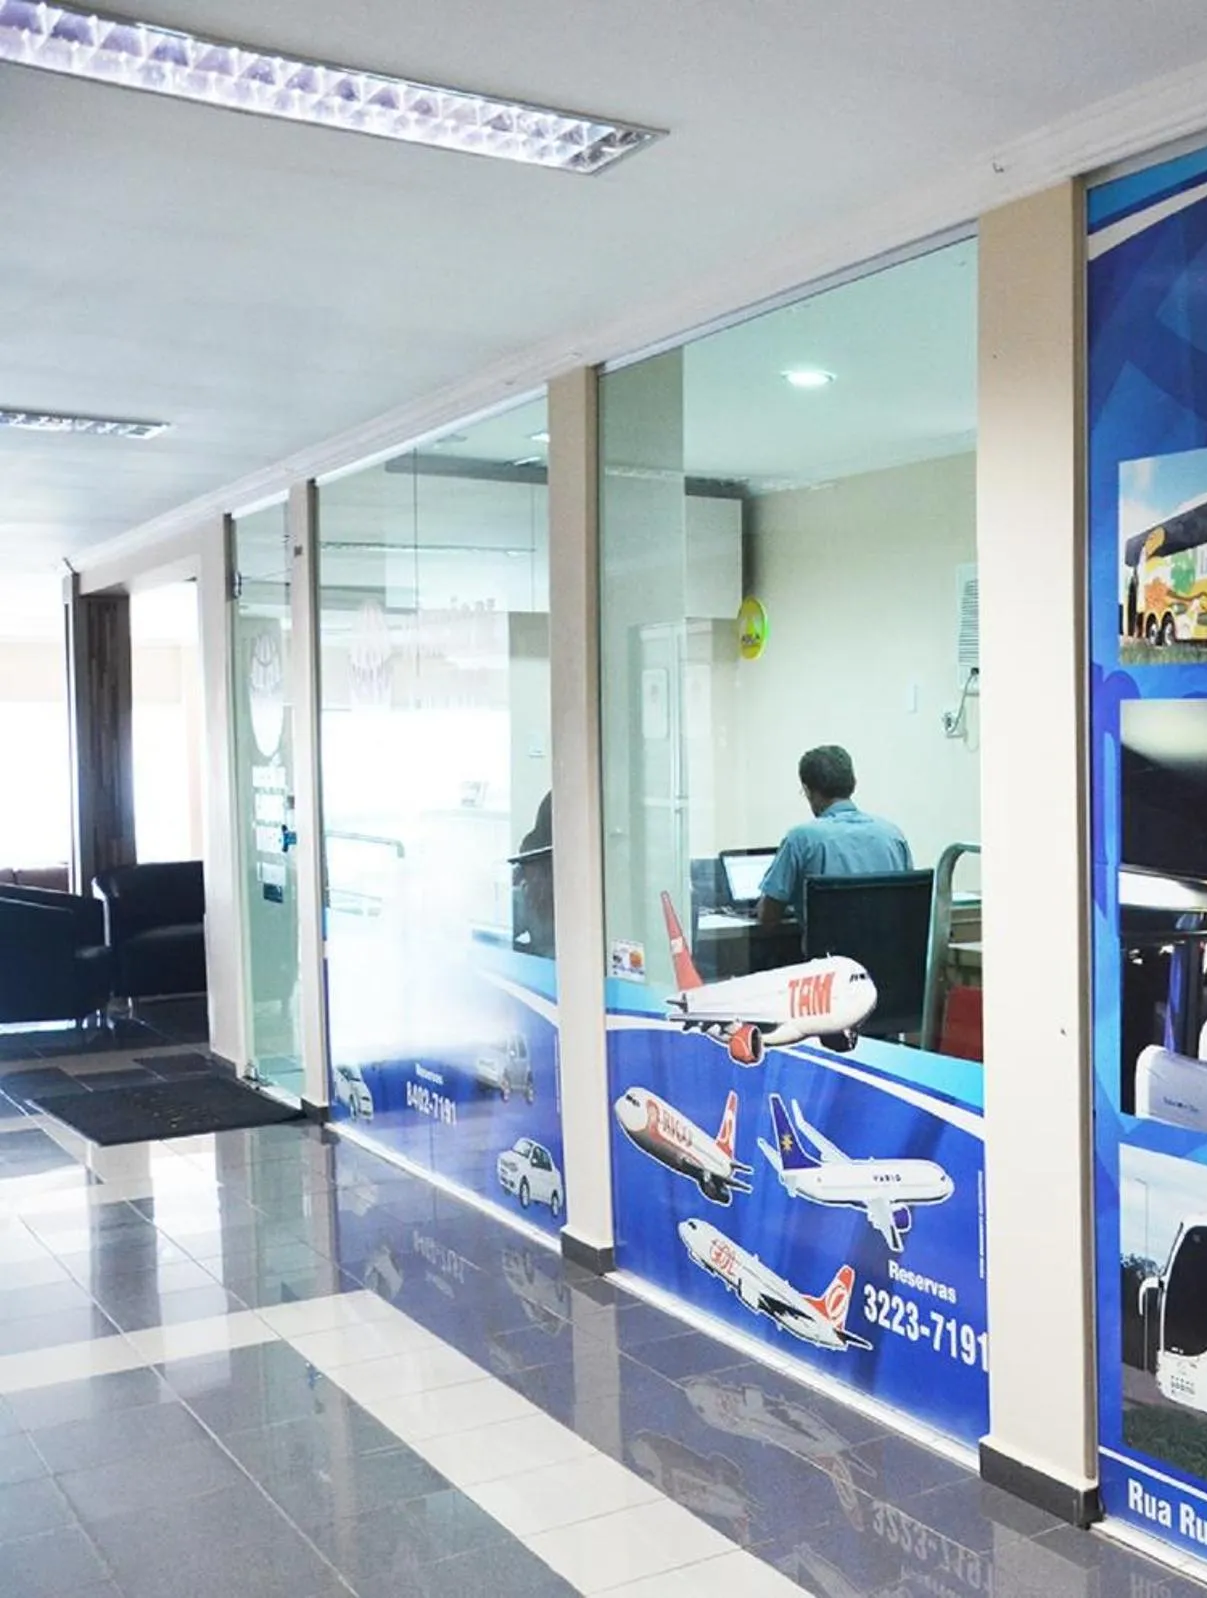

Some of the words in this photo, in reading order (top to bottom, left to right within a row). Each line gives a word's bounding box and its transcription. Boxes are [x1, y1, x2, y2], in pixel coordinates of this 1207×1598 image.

[788, 971, 835, 1019] TAM
[887, 1259, 957, 1304] Reservas
[863, 1283, 989, 1372] 3223-7191
[1128, 1477, 1172, 1528] Rua
